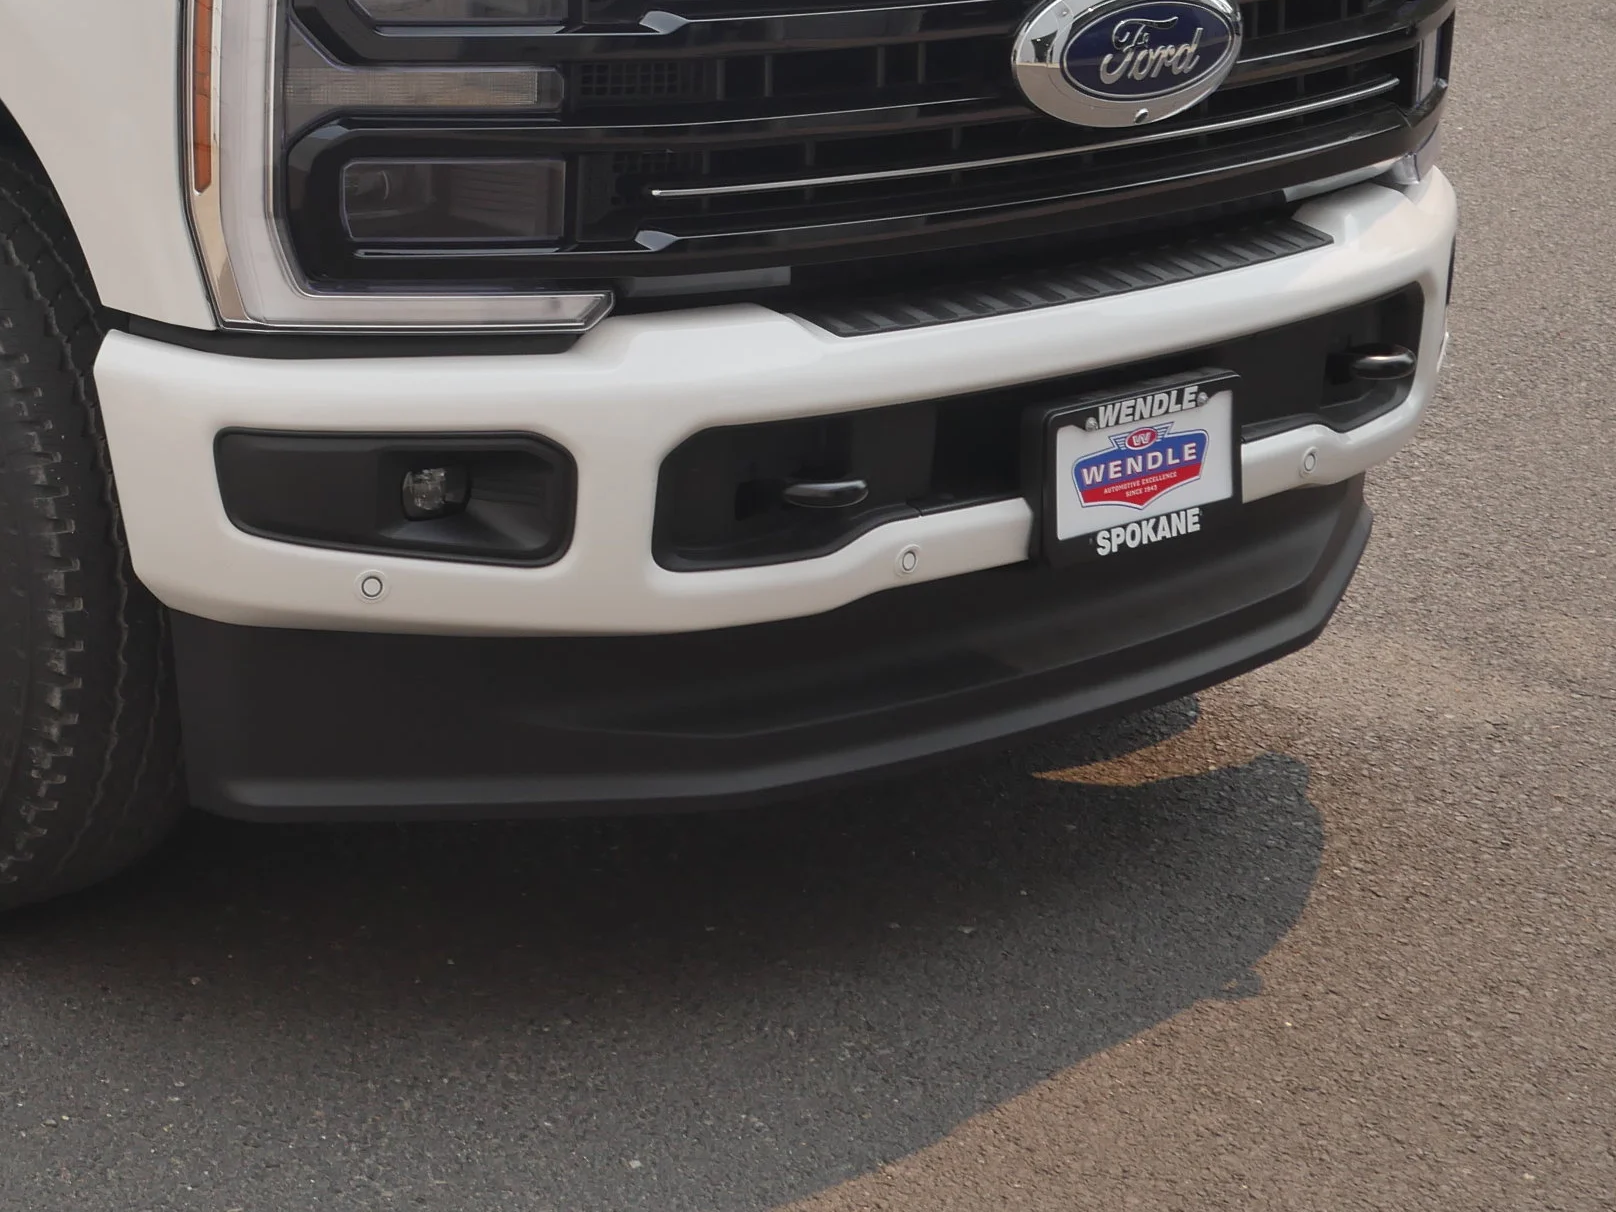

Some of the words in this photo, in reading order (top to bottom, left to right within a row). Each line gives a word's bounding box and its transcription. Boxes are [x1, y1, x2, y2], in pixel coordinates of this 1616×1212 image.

[1100, 16, 1204, 85] Ford
[1098, 386, 1198, 428] WENDLE
[1082, 442, 1197, 485] WENDLE
[1103, 480, 1141, 494] AUTOMOTIVE
[1141, 471, 1178, 486] EXCELLENCE
[1125, 487, 1143, 498] SINCE
[1096, 507, 1200, 556] SPOKANE
